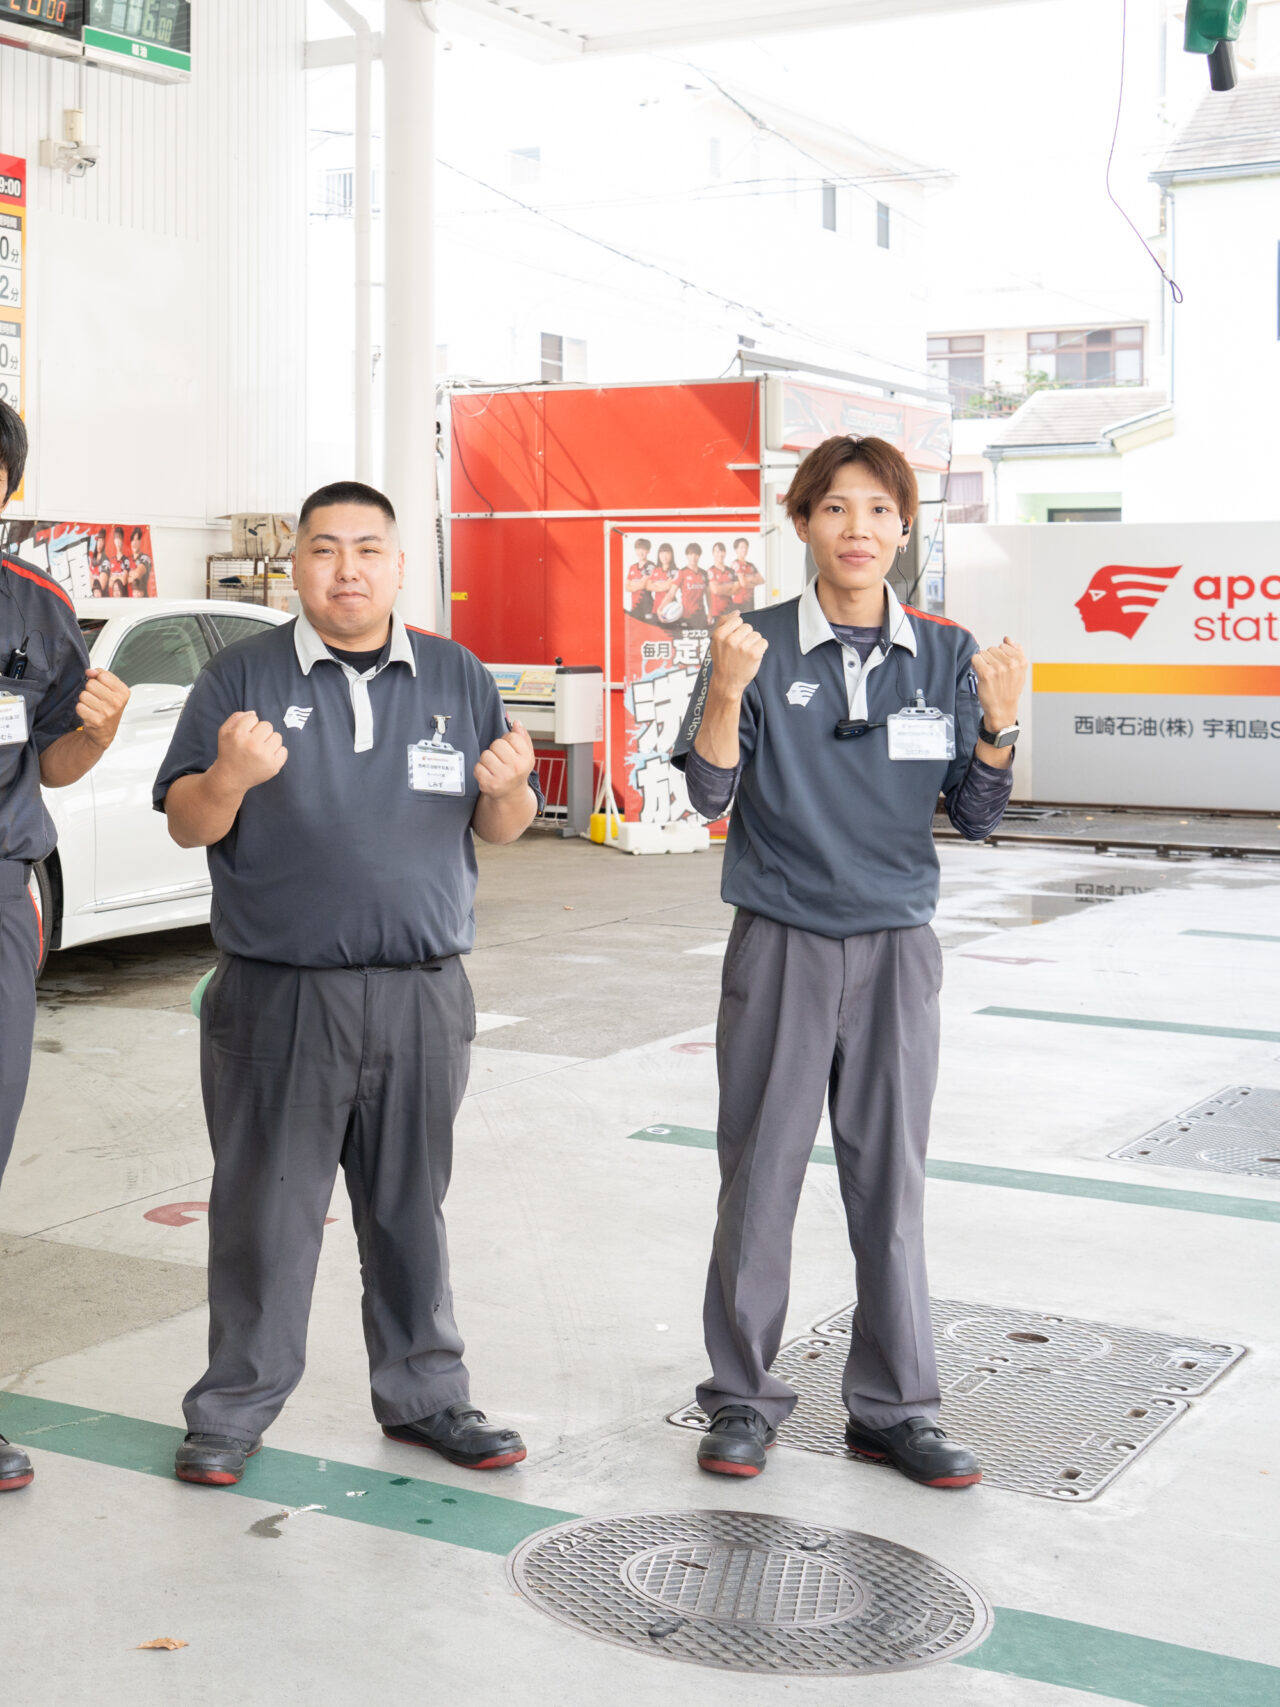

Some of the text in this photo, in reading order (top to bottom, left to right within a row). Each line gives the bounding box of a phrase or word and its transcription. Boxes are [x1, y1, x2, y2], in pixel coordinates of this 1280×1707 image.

[1194, 612, 1279, 642] stat
[1074, 715, 1194, 739] 西崎石油(株)
